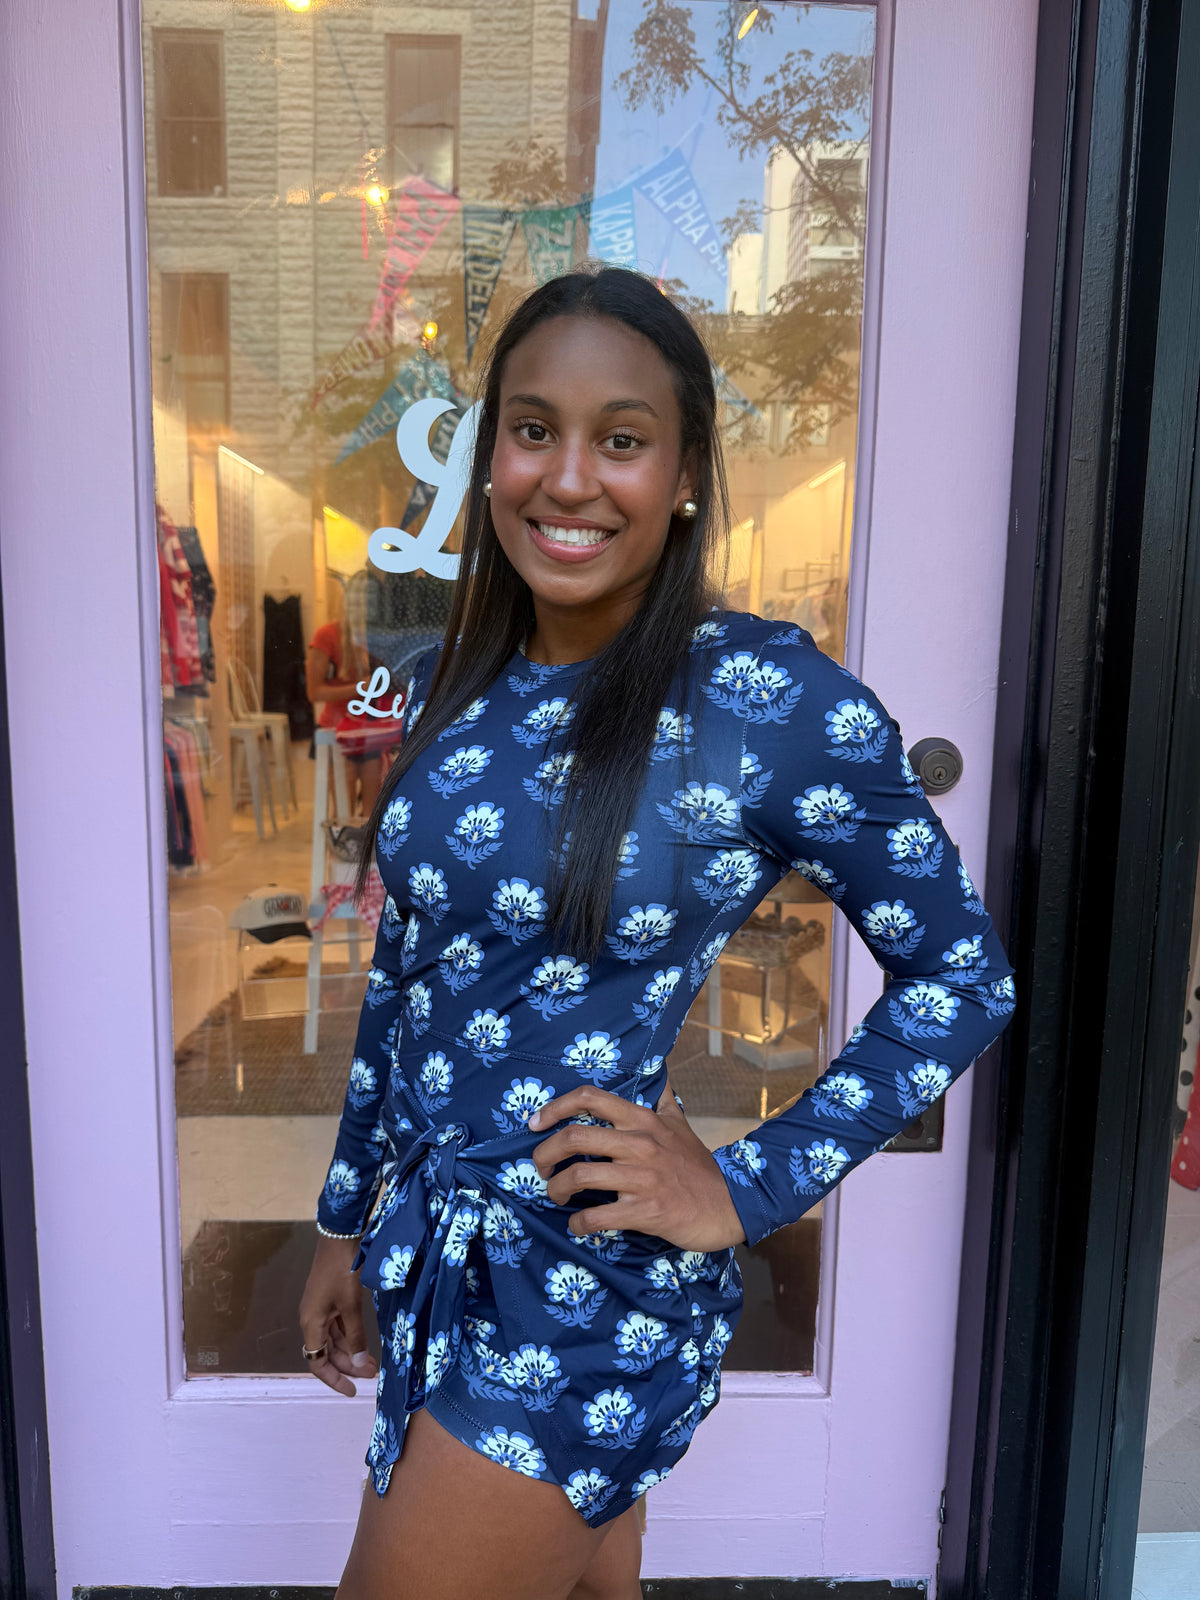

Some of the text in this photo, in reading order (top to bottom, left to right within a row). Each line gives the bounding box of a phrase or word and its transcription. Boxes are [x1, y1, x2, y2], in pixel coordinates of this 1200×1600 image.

[391, 188, 451, 257] PHI
[641, 165, 711, 245] ALPHA
[358, 401, 400, 442] PHI
